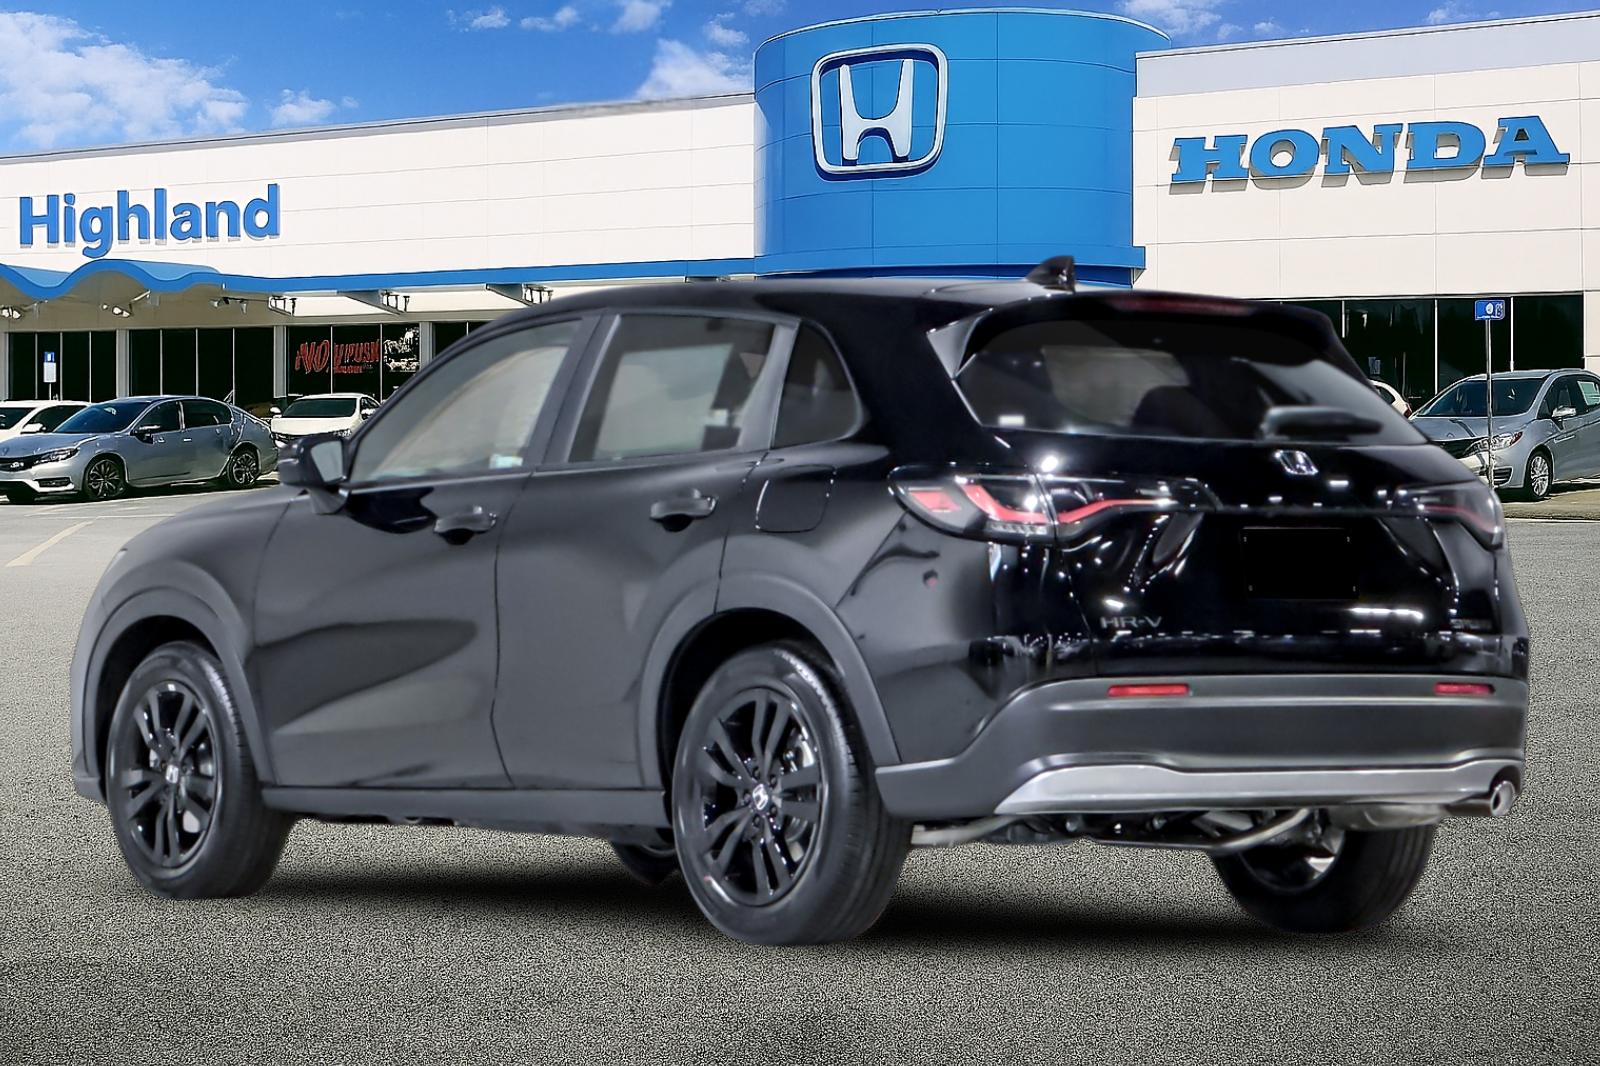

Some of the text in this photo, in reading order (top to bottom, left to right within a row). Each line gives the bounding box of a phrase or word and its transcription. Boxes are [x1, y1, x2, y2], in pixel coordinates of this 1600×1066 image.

[1170, 115, 1571, 184] HONDA
[18, 183, 281, 258] Highland
[1100, 616, 1162, 629] HR-V
